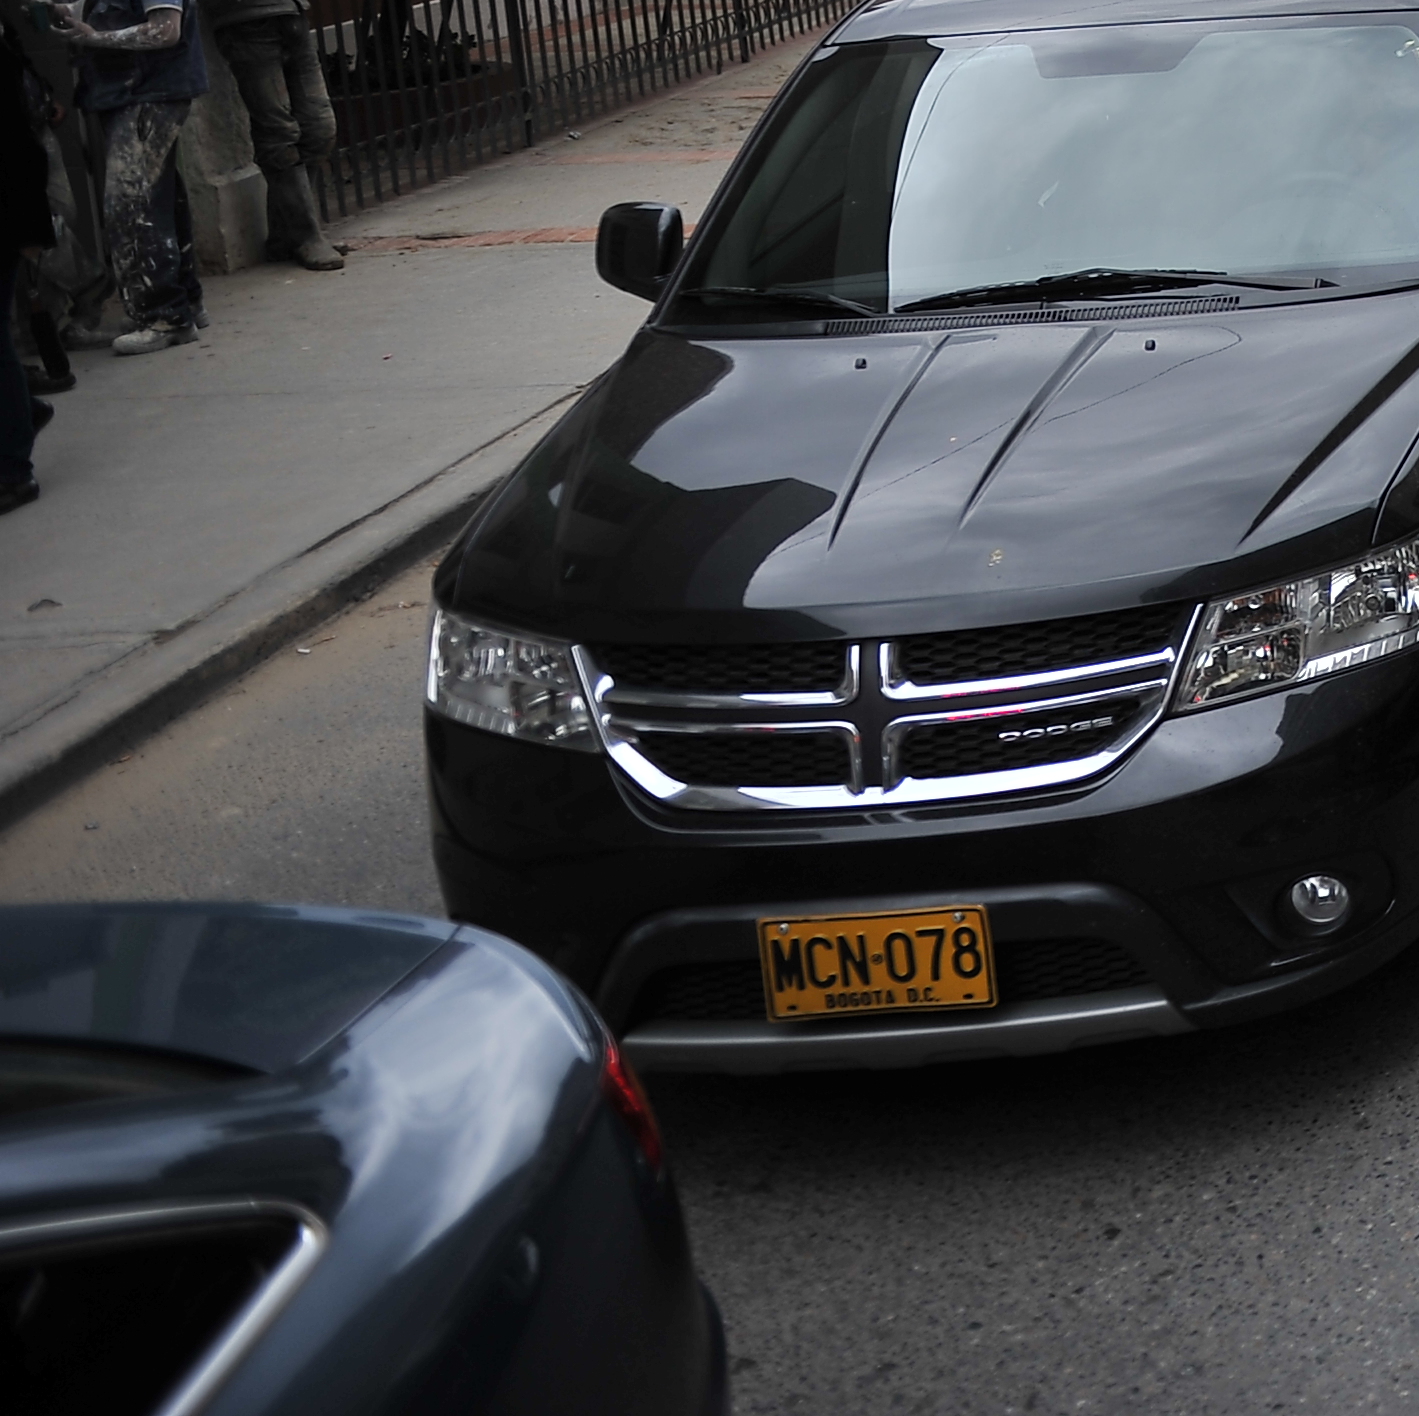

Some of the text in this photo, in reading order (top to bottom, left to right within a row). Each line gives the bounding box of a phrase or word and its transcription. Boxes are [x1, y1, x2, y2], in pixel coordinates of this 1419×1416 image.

[999, 716, 1113, 742] DODGE
[825, 986, 941, 1009] BOGOTA D.C.
